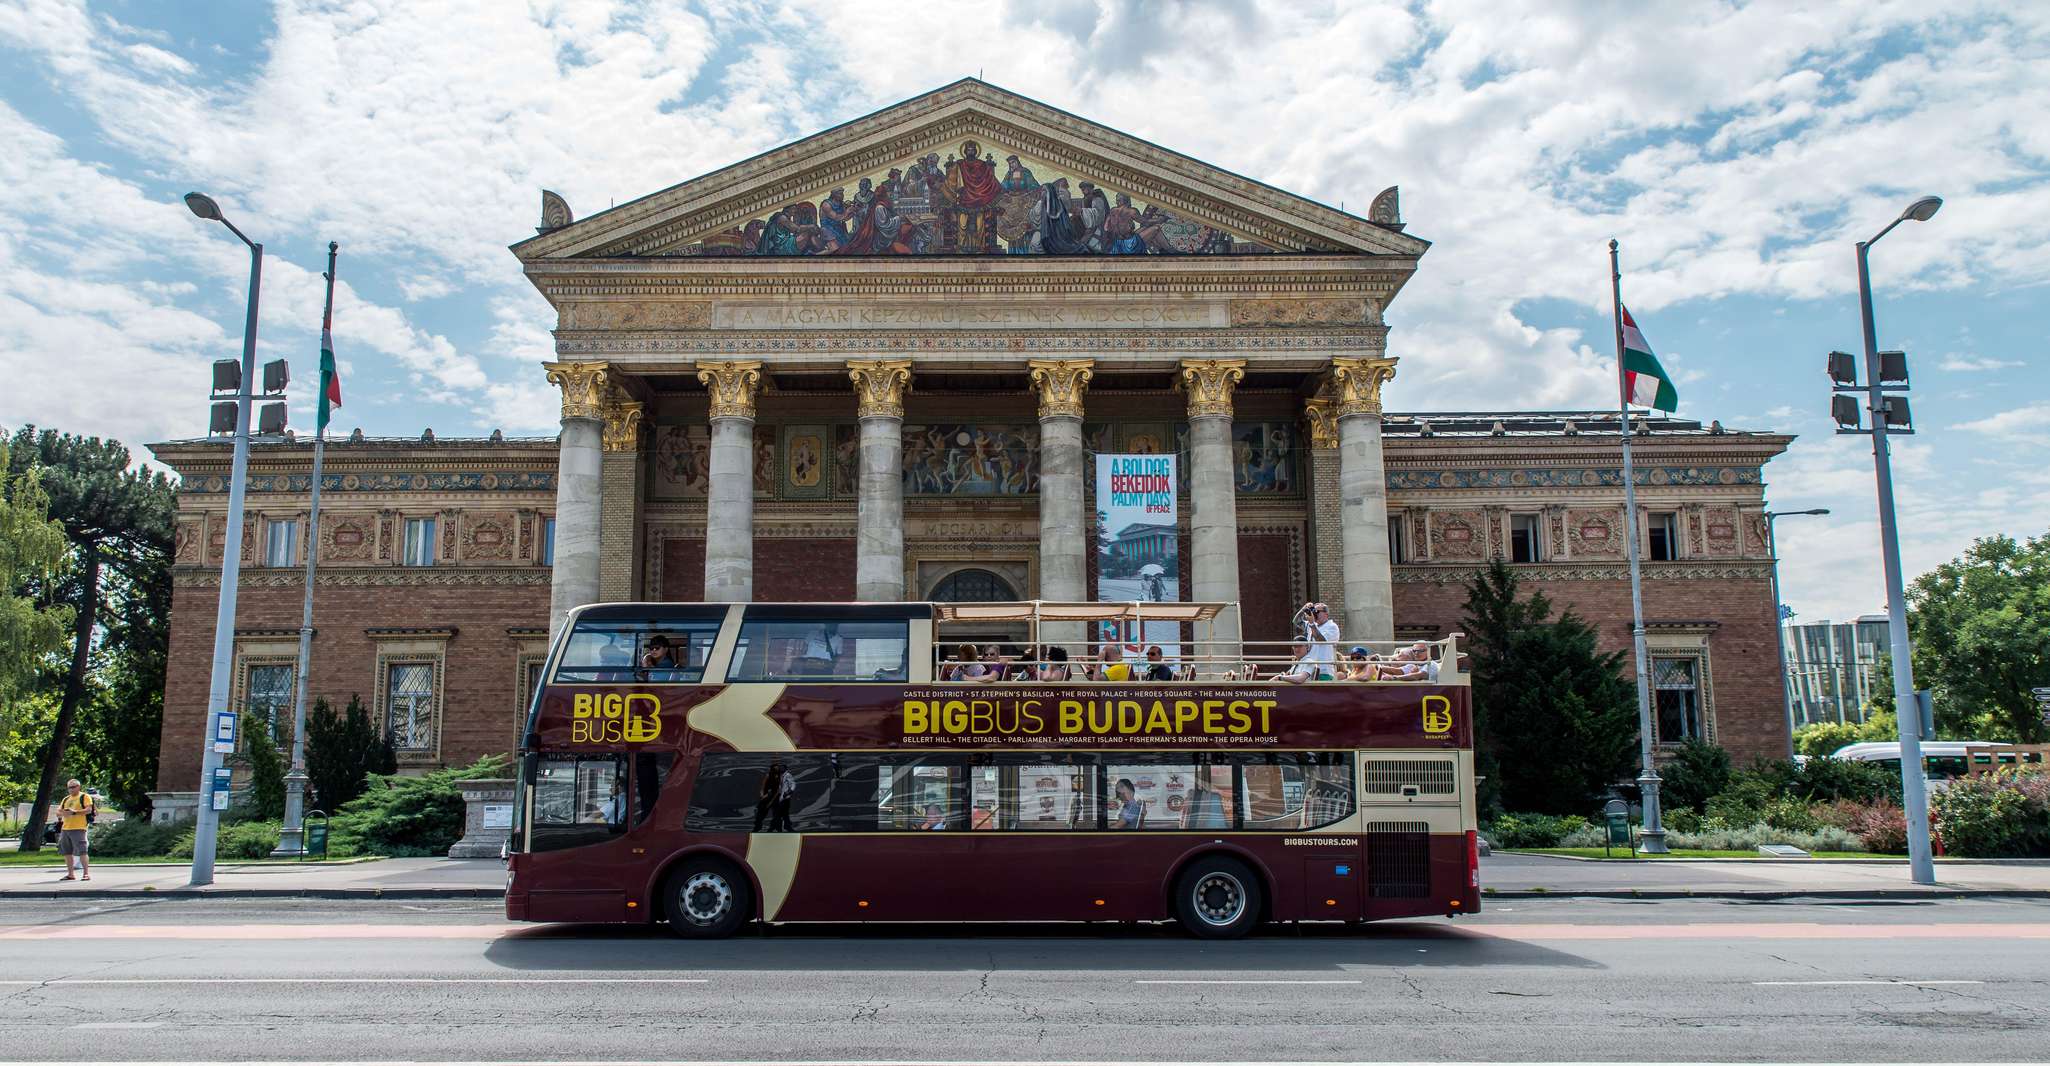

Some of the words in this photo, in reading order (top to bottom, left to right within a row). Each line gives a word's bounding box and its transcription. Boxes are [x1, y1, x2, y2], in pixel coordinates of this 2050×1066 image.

[1112, 458, 1120, 475] A
[1123, 458, 1169, 475] BOLDOG
[1112, 492, 1143, 506] PALMY
[1146, 492, 1171, 506] DAYS
[1153, 505, 1171, 513] PEACE
[903, 690, 930, 698] CASTLE
[932, 690, 964, 698] DISTRICT
[970, 690, 980, 698] ST
[981, 690, 1021, 698] STEPHEN'S
[1022, 690, 1055, 698] BASILICA
[1061, 690, 1075, 698] THE
[1077, 690, 1098, 698] ROYAL
[1101, 690, 1128, 698] PALACE
[1134, 690, 1162, 698] HEROES
[1164, 690, 1193, 698] SQUARE
[1199, 690, 1213, 698] THE
[1214, 690, 1233, 698] MAIN
[1235, 690, 1277, 698] SYNAGOGUE
[574, 694, 623, 718] BIG
[1059, 700, 1278, 734] BUDAPEST
[573, 720, 622, 743] BUS
[1284, 838, 1358, 846] BIGBUSTOURS.COM
